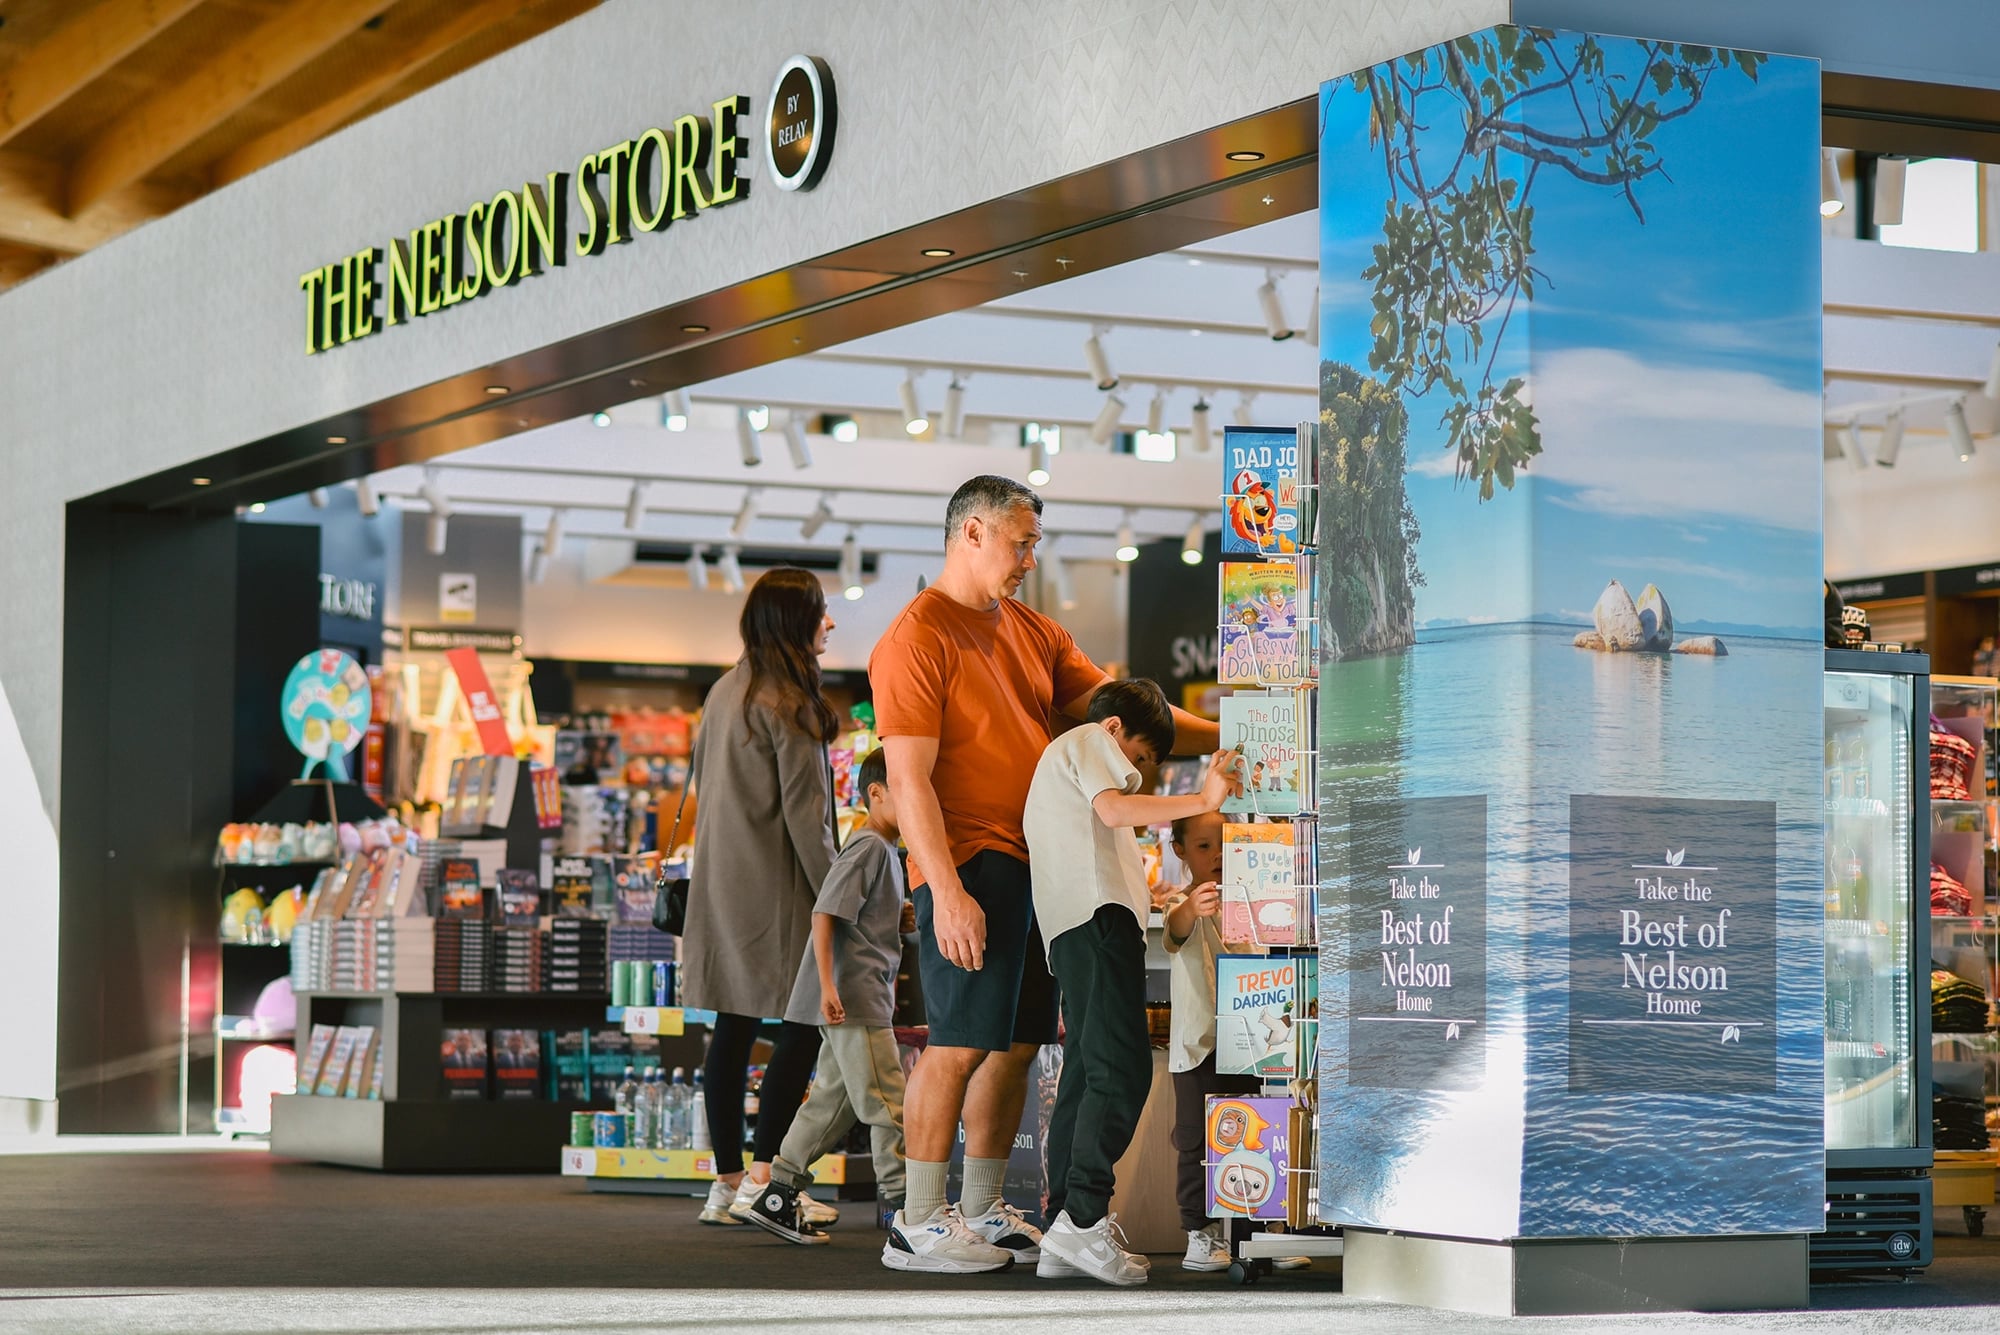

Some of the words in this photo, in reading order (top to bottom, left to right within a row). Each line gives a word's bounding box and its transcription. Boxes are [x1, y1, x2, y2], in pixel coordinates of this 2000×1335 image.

[787, 93, 800, 115] BY
[778, 119, 808, 147] RELAY
[299, 246, 376, 355] THE
[386, 171, 562, 327] NELSON
[576, 93, 741, 257] STORE
[1232, 447, 1273, 469] DAD
[1236, 637, 1278, 660] GUESS
[1228, 656, 1271, 679] DOING
[1248, 709, 1268, 723] The
[1389, 876, 1416, 899] Take
[1420, 875, 1440, 899] the
[1635, 876, 1679, 900] Take
[1683, 878, 1712, 901] the
[1380, 909, 1423, 945] Best
[1429, 905, 1454, 945] of
[1619, 909, 1689, 948] Best
[1697, 908, 1732, 948] of
[1236, 966, 1294, 993] TREVO
[1381, 947, 1452, 988] Nelson
[1621, 950, 1729, 991] Nelson
[1232, 989, 1287, 1011] DARING
[1396, 989, 1433, 1011] Home
[1646, 991, 1702, 1015] Home
[1012, 1133, 1034, 1149] son
[1893, 1239, 1911, 1250] idw
